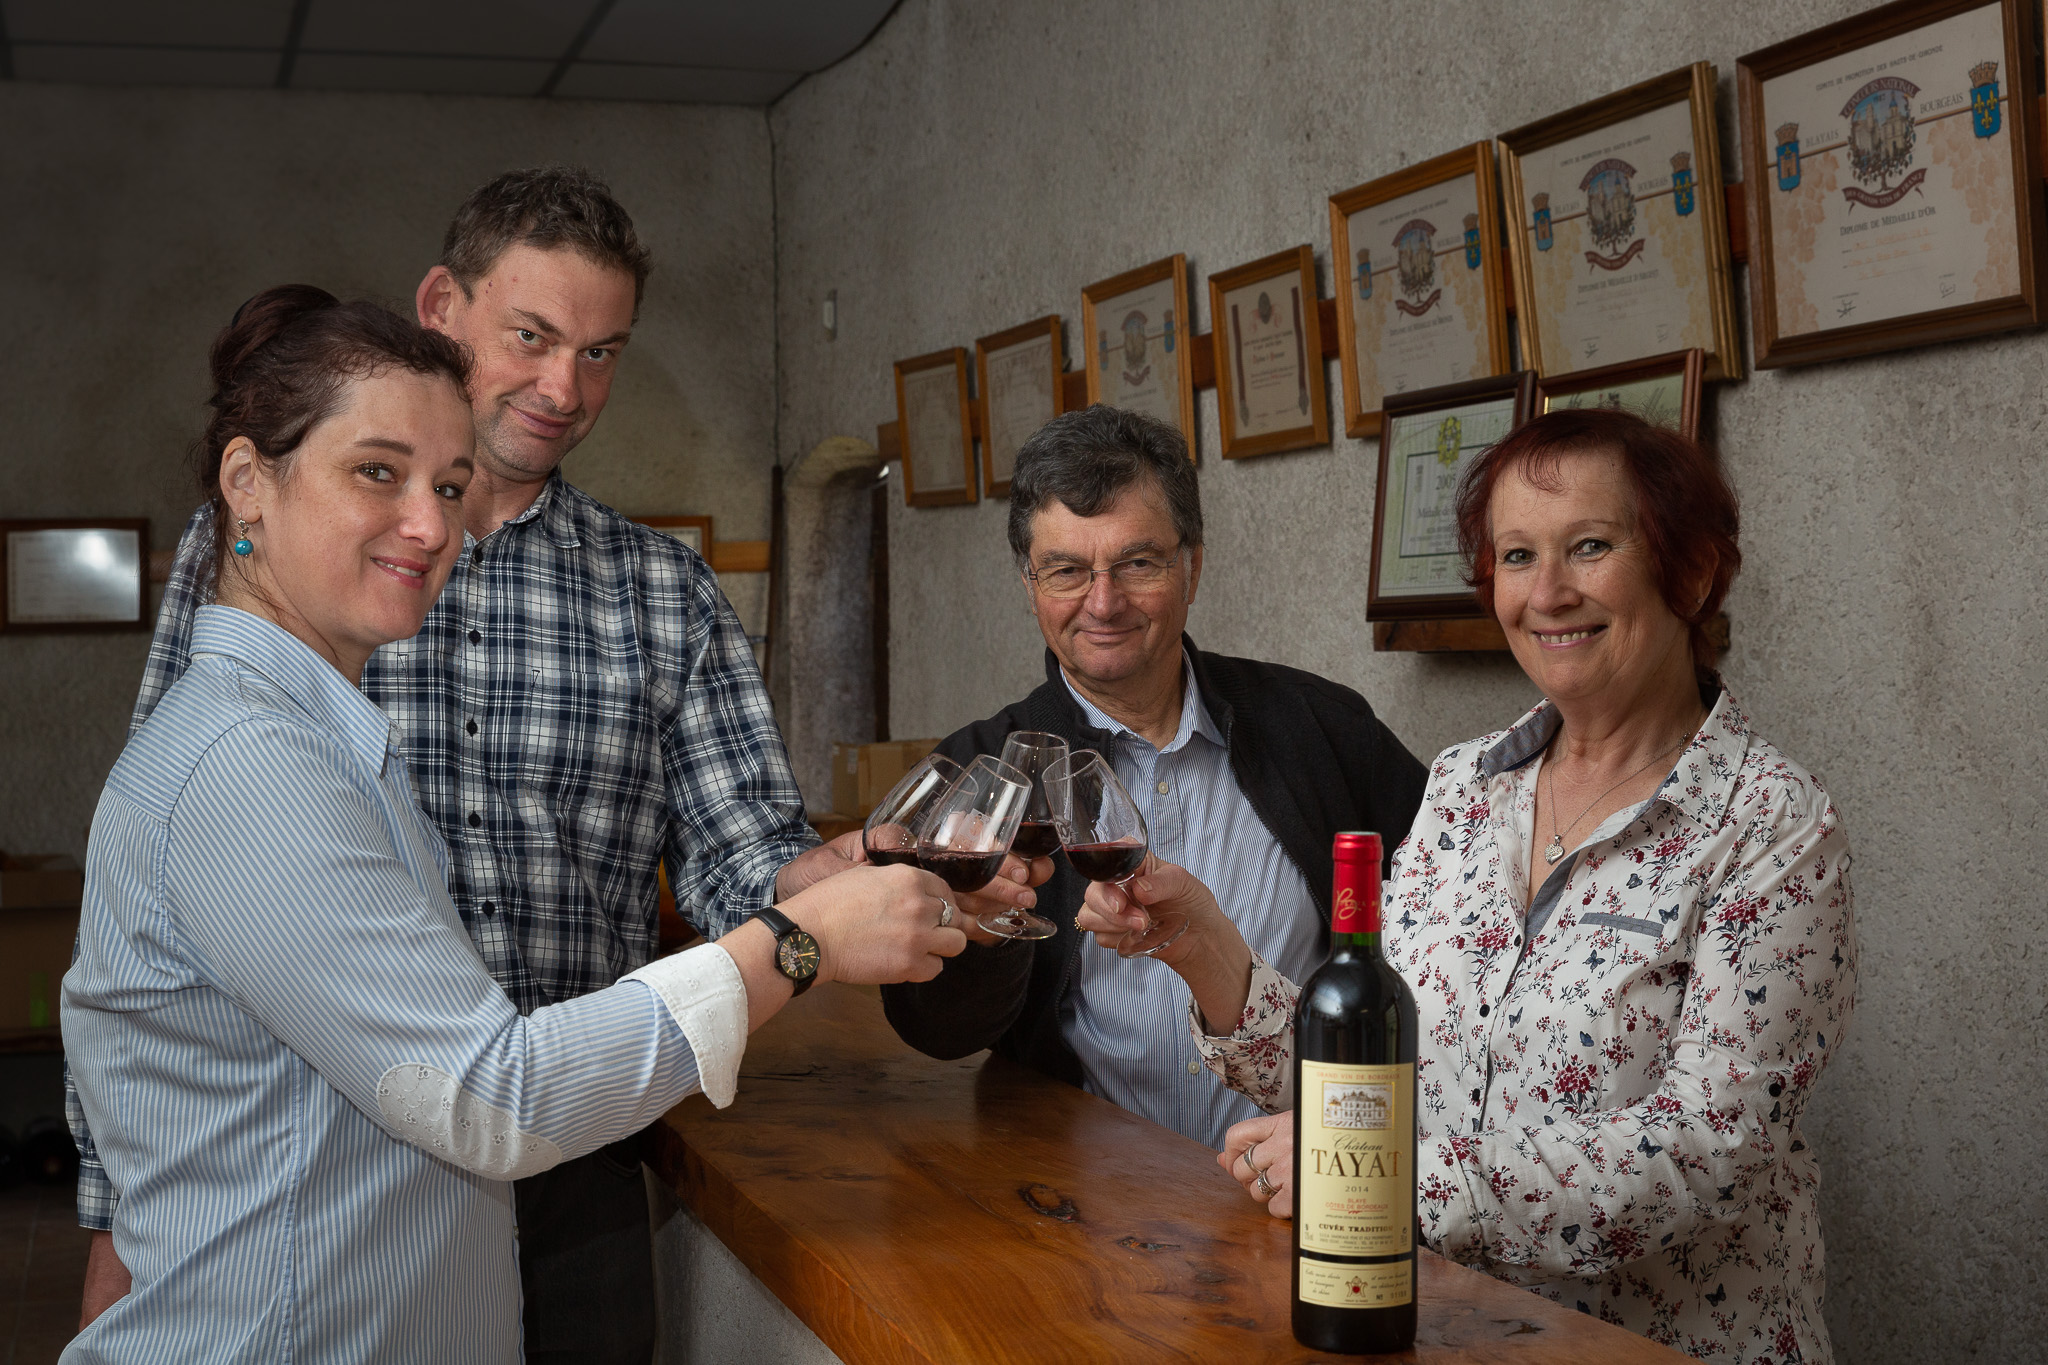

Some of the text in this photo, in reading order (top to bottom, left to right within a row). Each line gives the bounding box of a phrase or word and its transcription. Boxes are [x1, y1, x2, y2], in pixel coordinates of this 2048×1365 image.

[1880, 78, 1915, 97] NATIONAL
[1920, 92, 1964, 114] BOURGEAIS
[1332, 1132, 1384, 1151] Château
[1311, 1148, 1402, 1178] TAYAT
[1345, 1185, 1369, 1193] 2014
[1319, 1222, 1393, 1233] CUVÉE TRADITION
